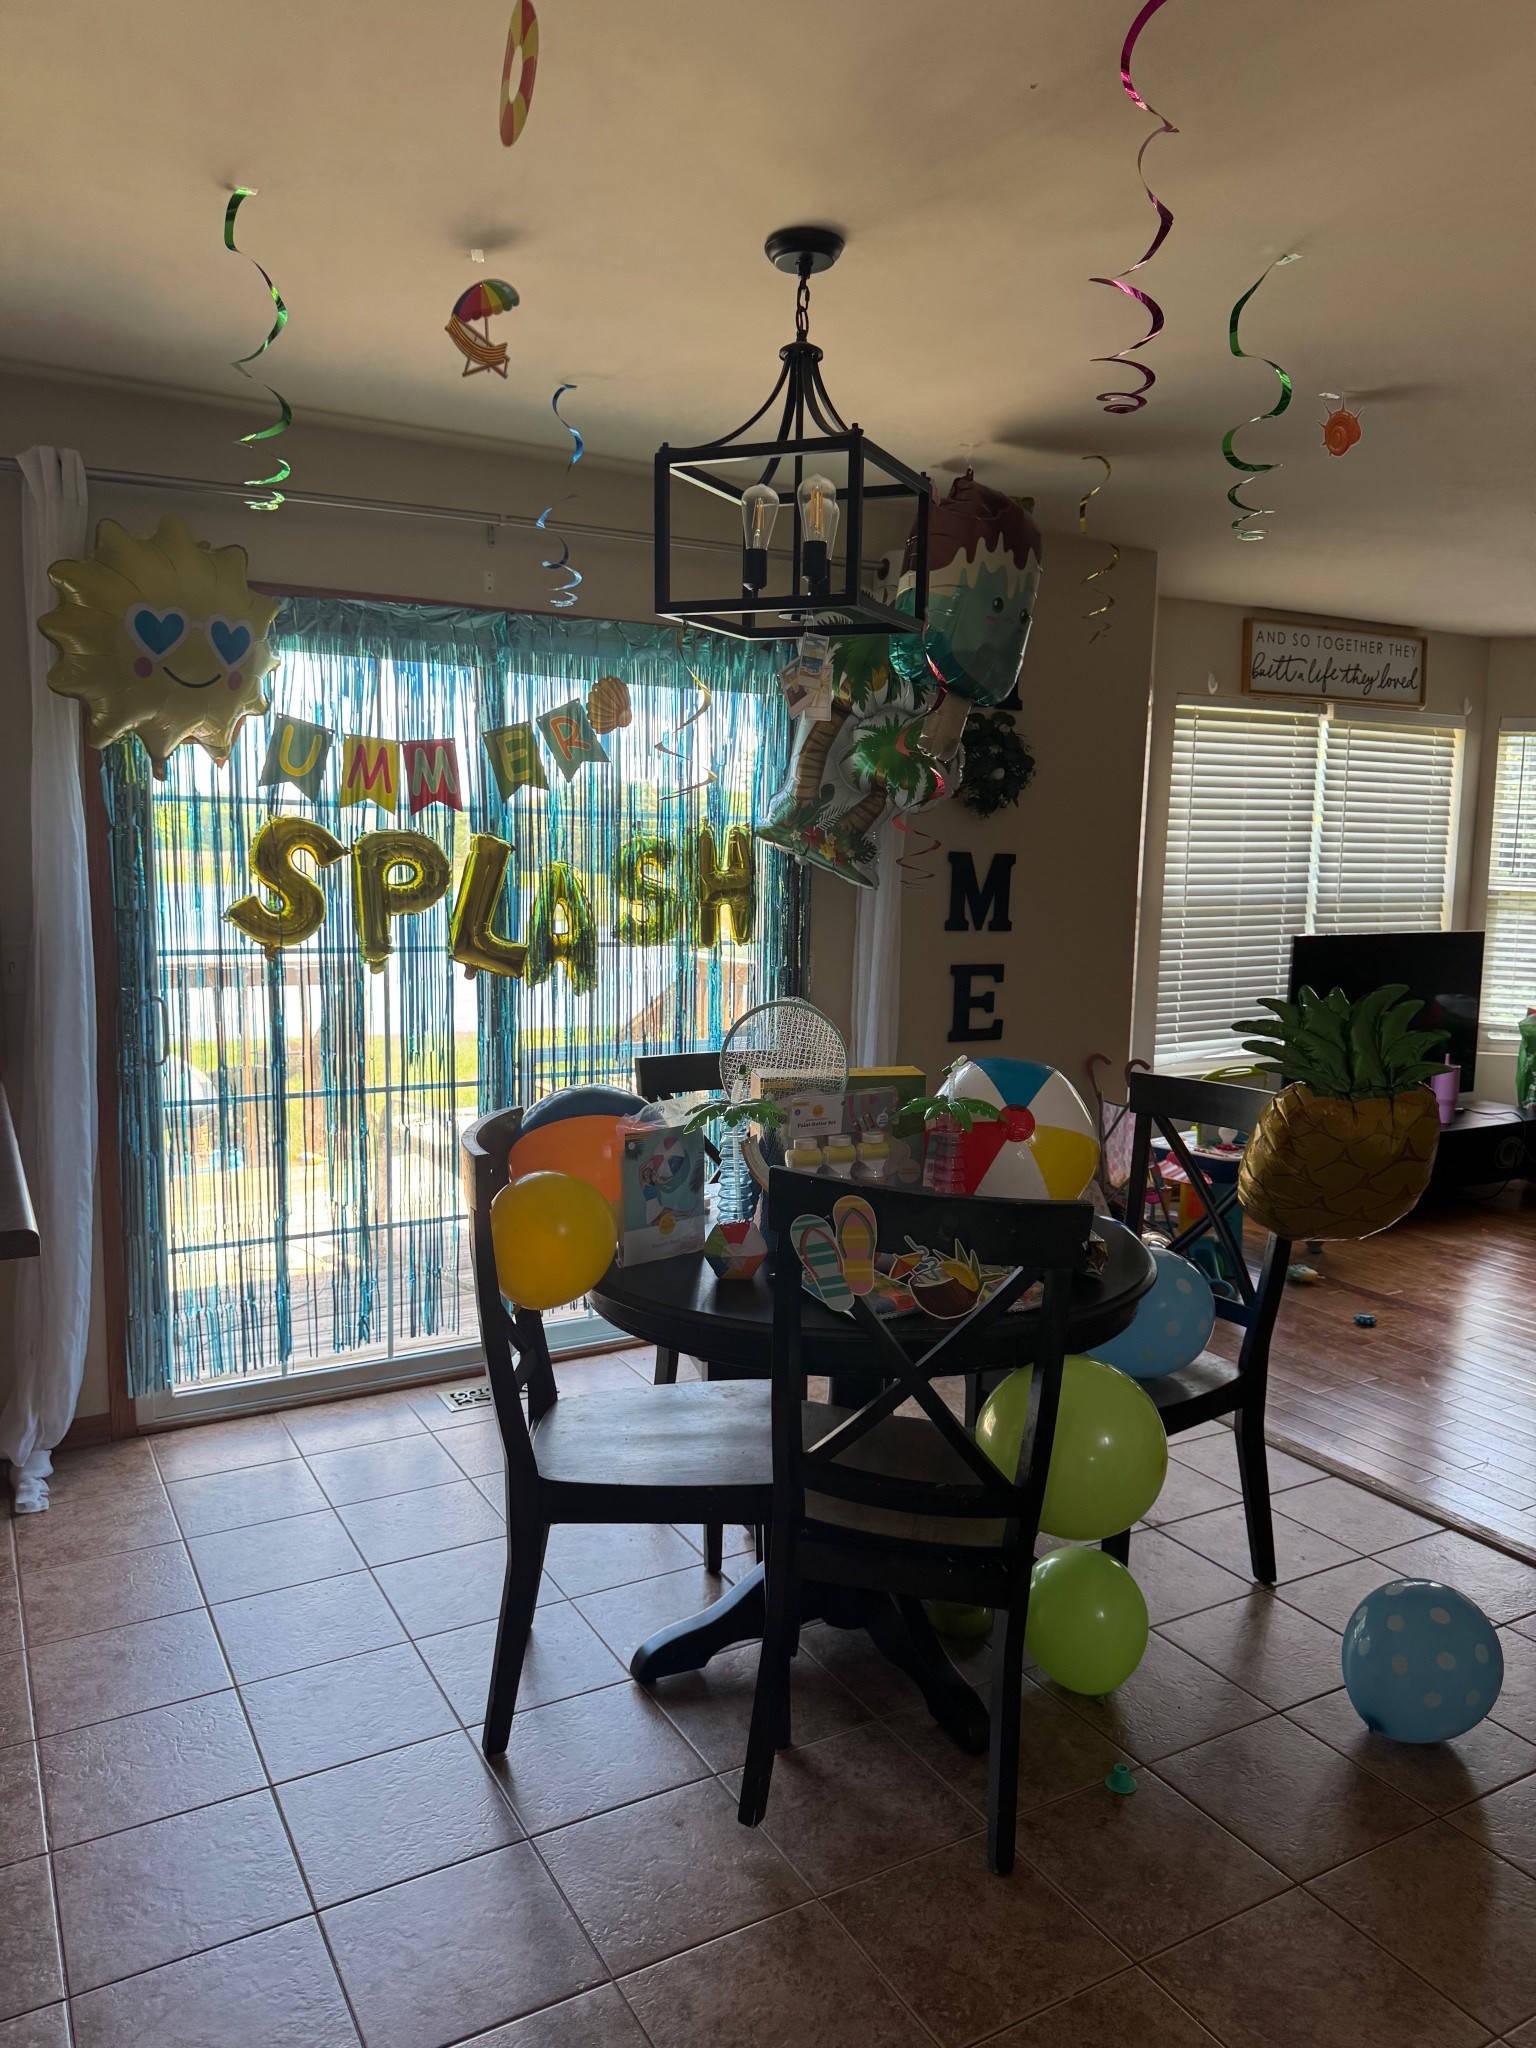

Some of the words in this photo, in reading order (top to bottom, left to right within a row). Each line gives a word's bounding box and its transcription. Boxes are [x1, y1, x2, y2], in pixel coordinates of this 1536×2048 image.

[1252, 652, 1307, 683] built
[1308, 657, 1339, 692] life
[1339, 663, 1380, 696] they
[1377, 663, 1418, 690] loved
[1256, 630, 1286, 645] AND
[1292, 633, 1310, 648] SO
[1317, 635, 1383, 656] TOGETHER
[1389, 643, 1418, 658] THEY
[279, 716, 591, 797] UMMER
[227, 812, 755, 997] SPLASH
